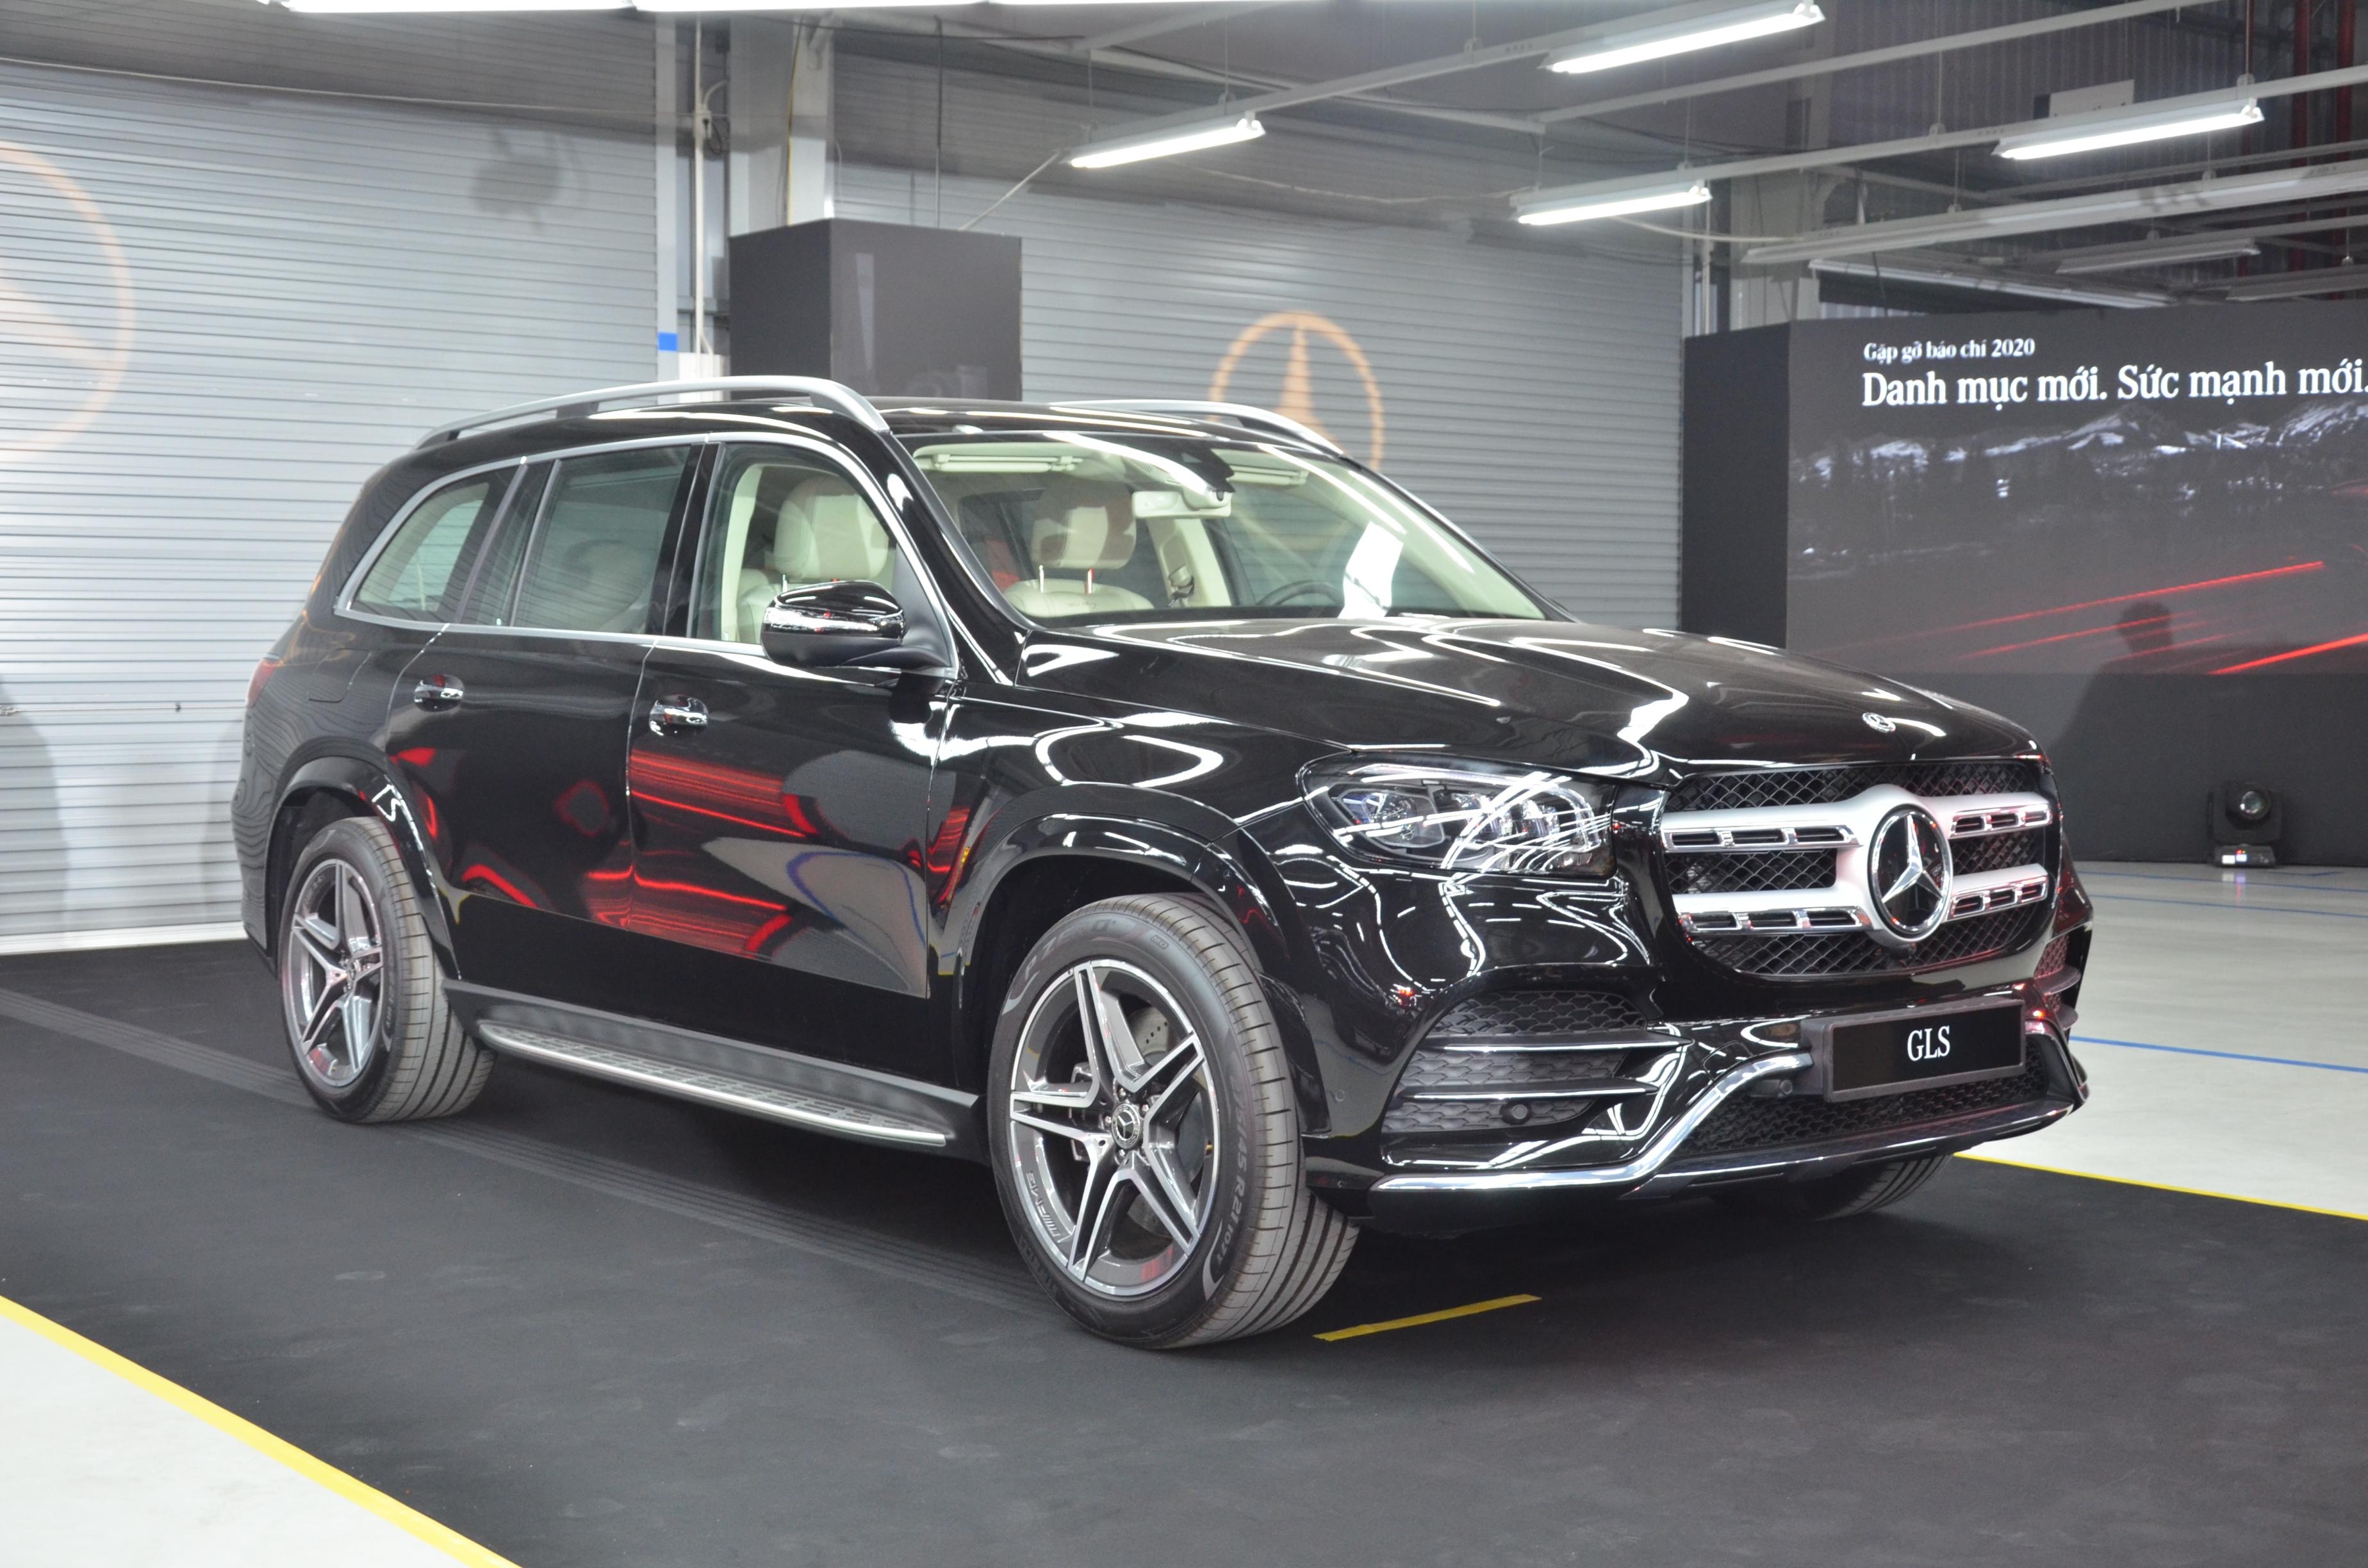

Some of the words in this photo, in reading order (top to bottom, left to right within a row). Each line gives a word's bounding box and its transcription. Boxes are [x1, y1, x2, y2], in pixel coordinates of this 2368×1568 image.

[1863, 342, 1898, 364] Gặp
[1925, 340, 1957, 359] báo
[1960, 339, 1987, 358] chí
[1991, 338, 2035, 357] 2020
[1862, 371, 1948, 407] Danh
[1957, 377, 2028, 412] mục
[2036, 365, 2108, 402] mới.
[2117, 364, 2180, 400] Sức
[2188, 361, 2288, 405] mạnh
[1907, 1025, 1951, 1061] GLS
